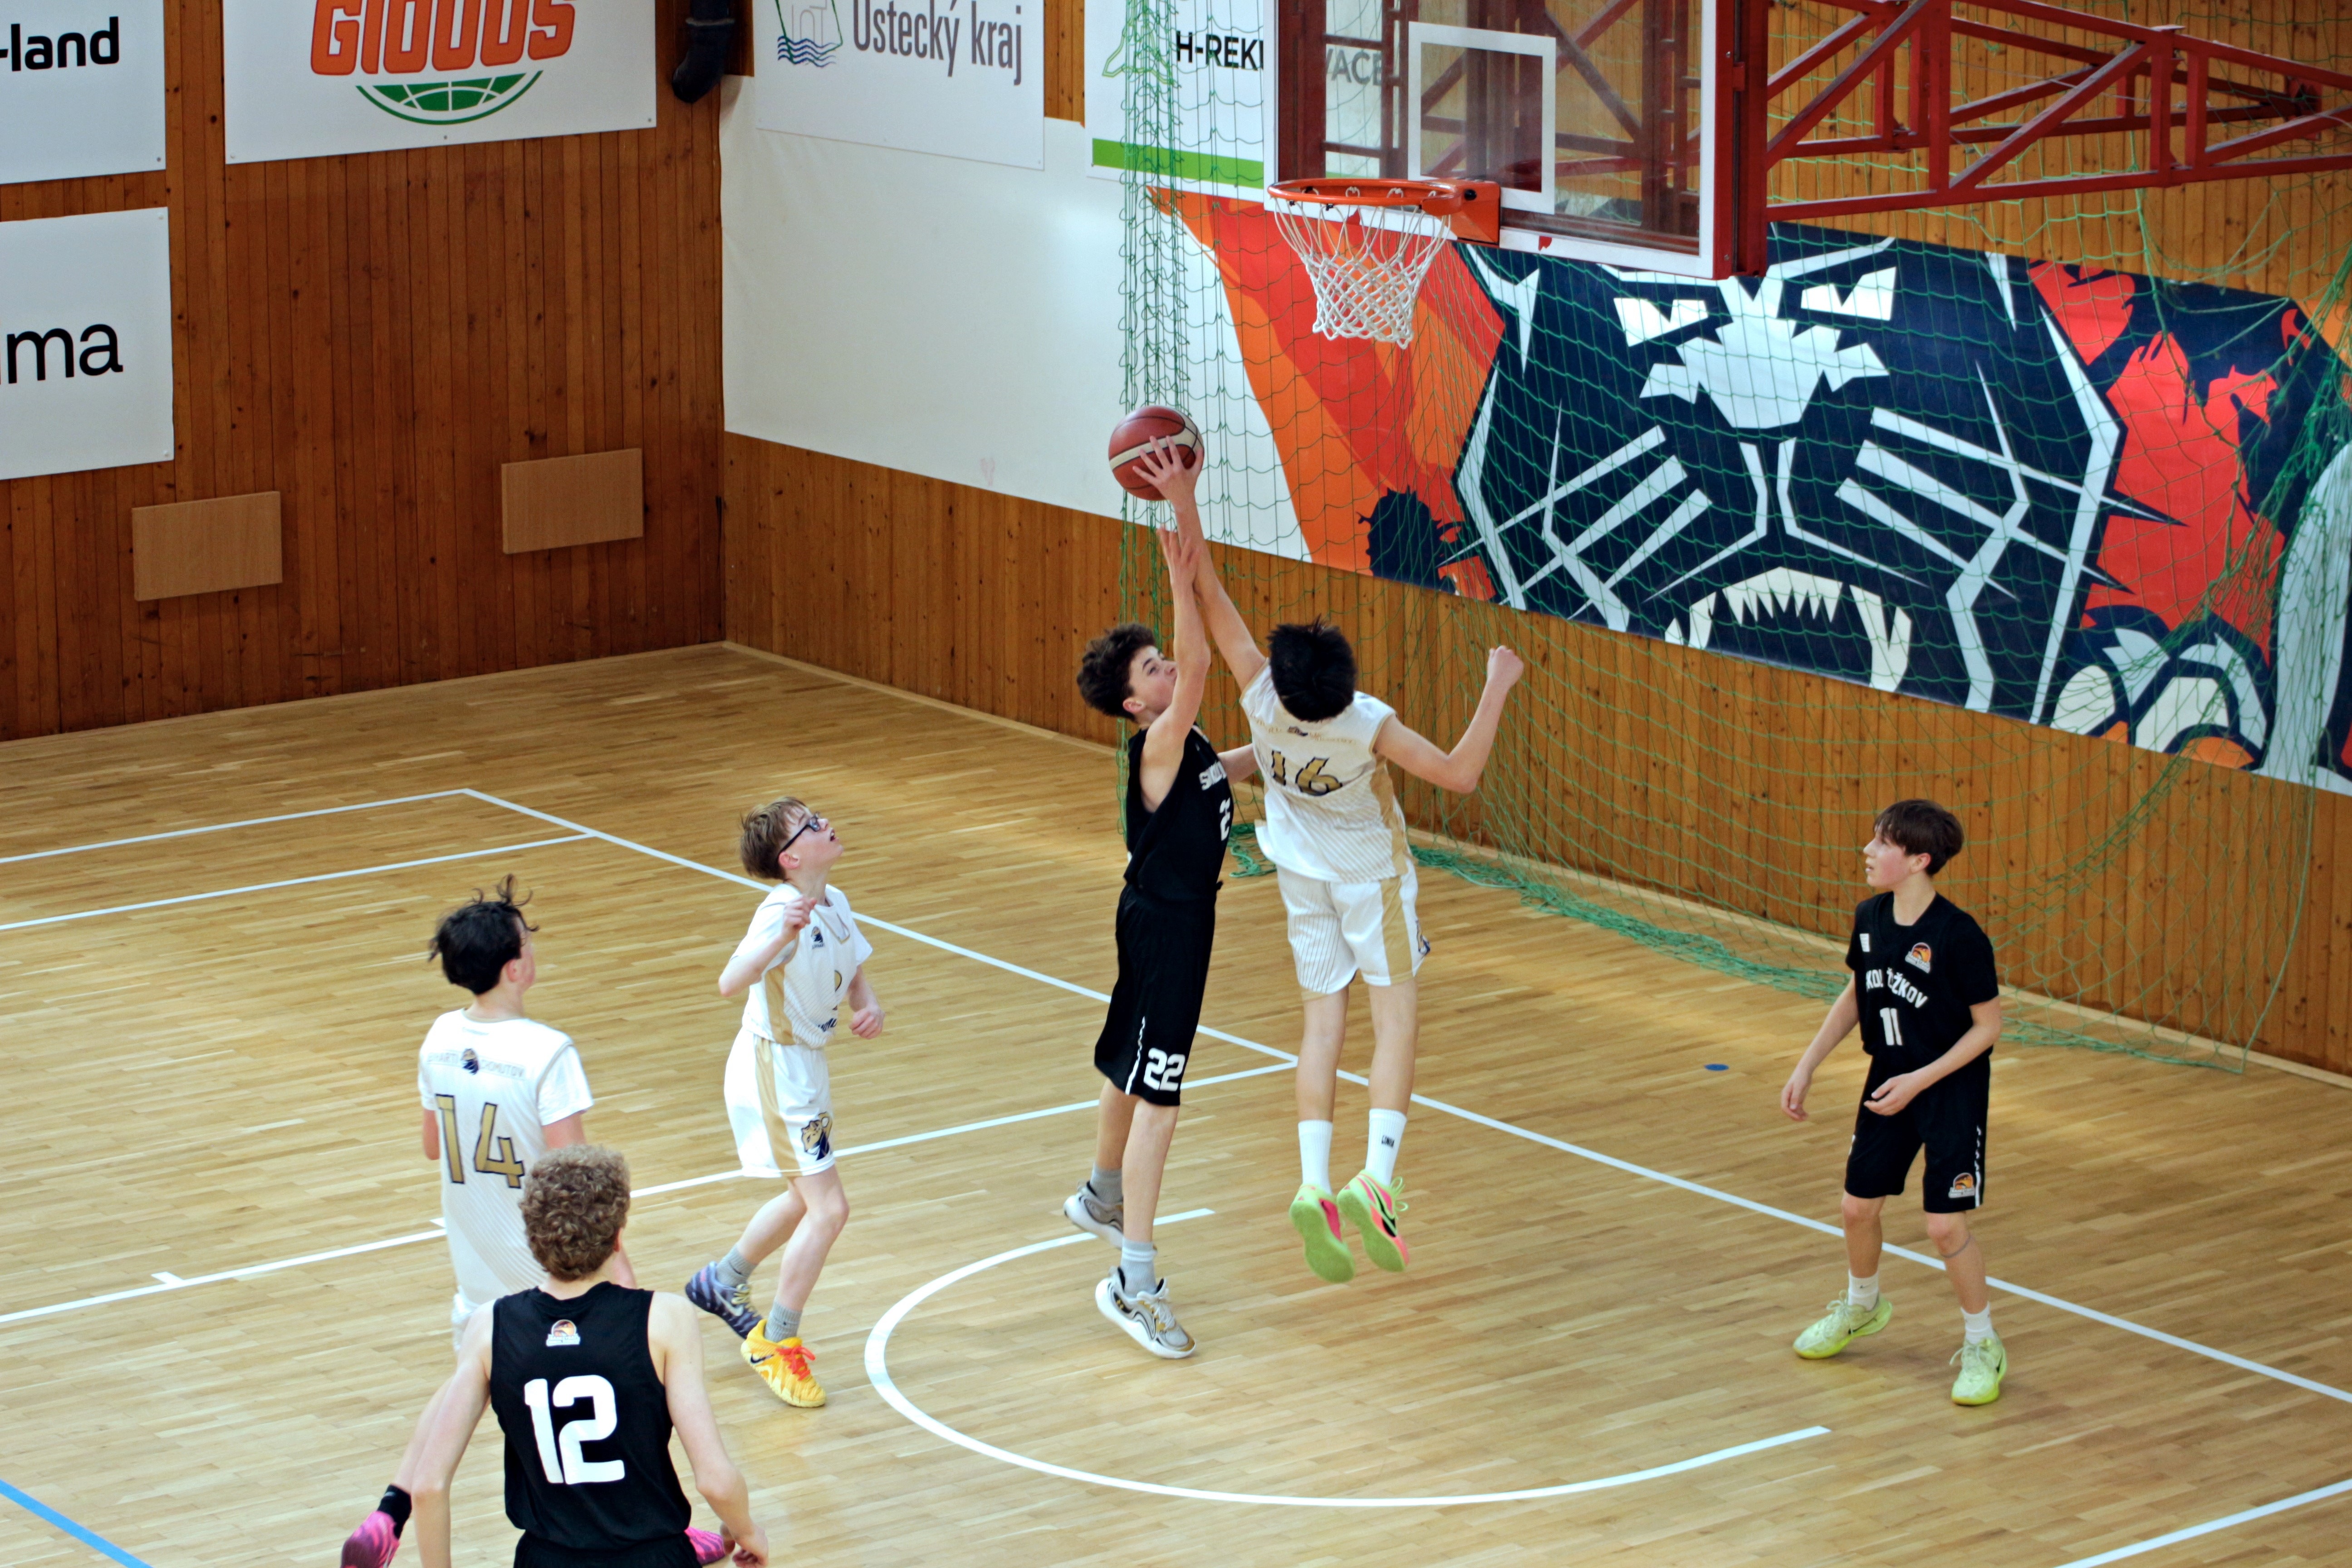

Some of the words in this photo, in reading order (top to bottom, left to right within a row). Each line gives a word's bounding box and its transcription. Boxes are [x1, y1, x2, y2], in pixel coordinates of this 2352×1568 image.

[971, 0, 1021, 86] kraj
[1176, 30, 1264, 71] H-REK
[1271, 750, 1343, 797] 16
[1880, 1007, 1903, 1045] 11
[1144, 1048, 1186, 1092] 22
[436, 1093, 525, 1189] 14
[524, 1375, 625, 1485] 12
